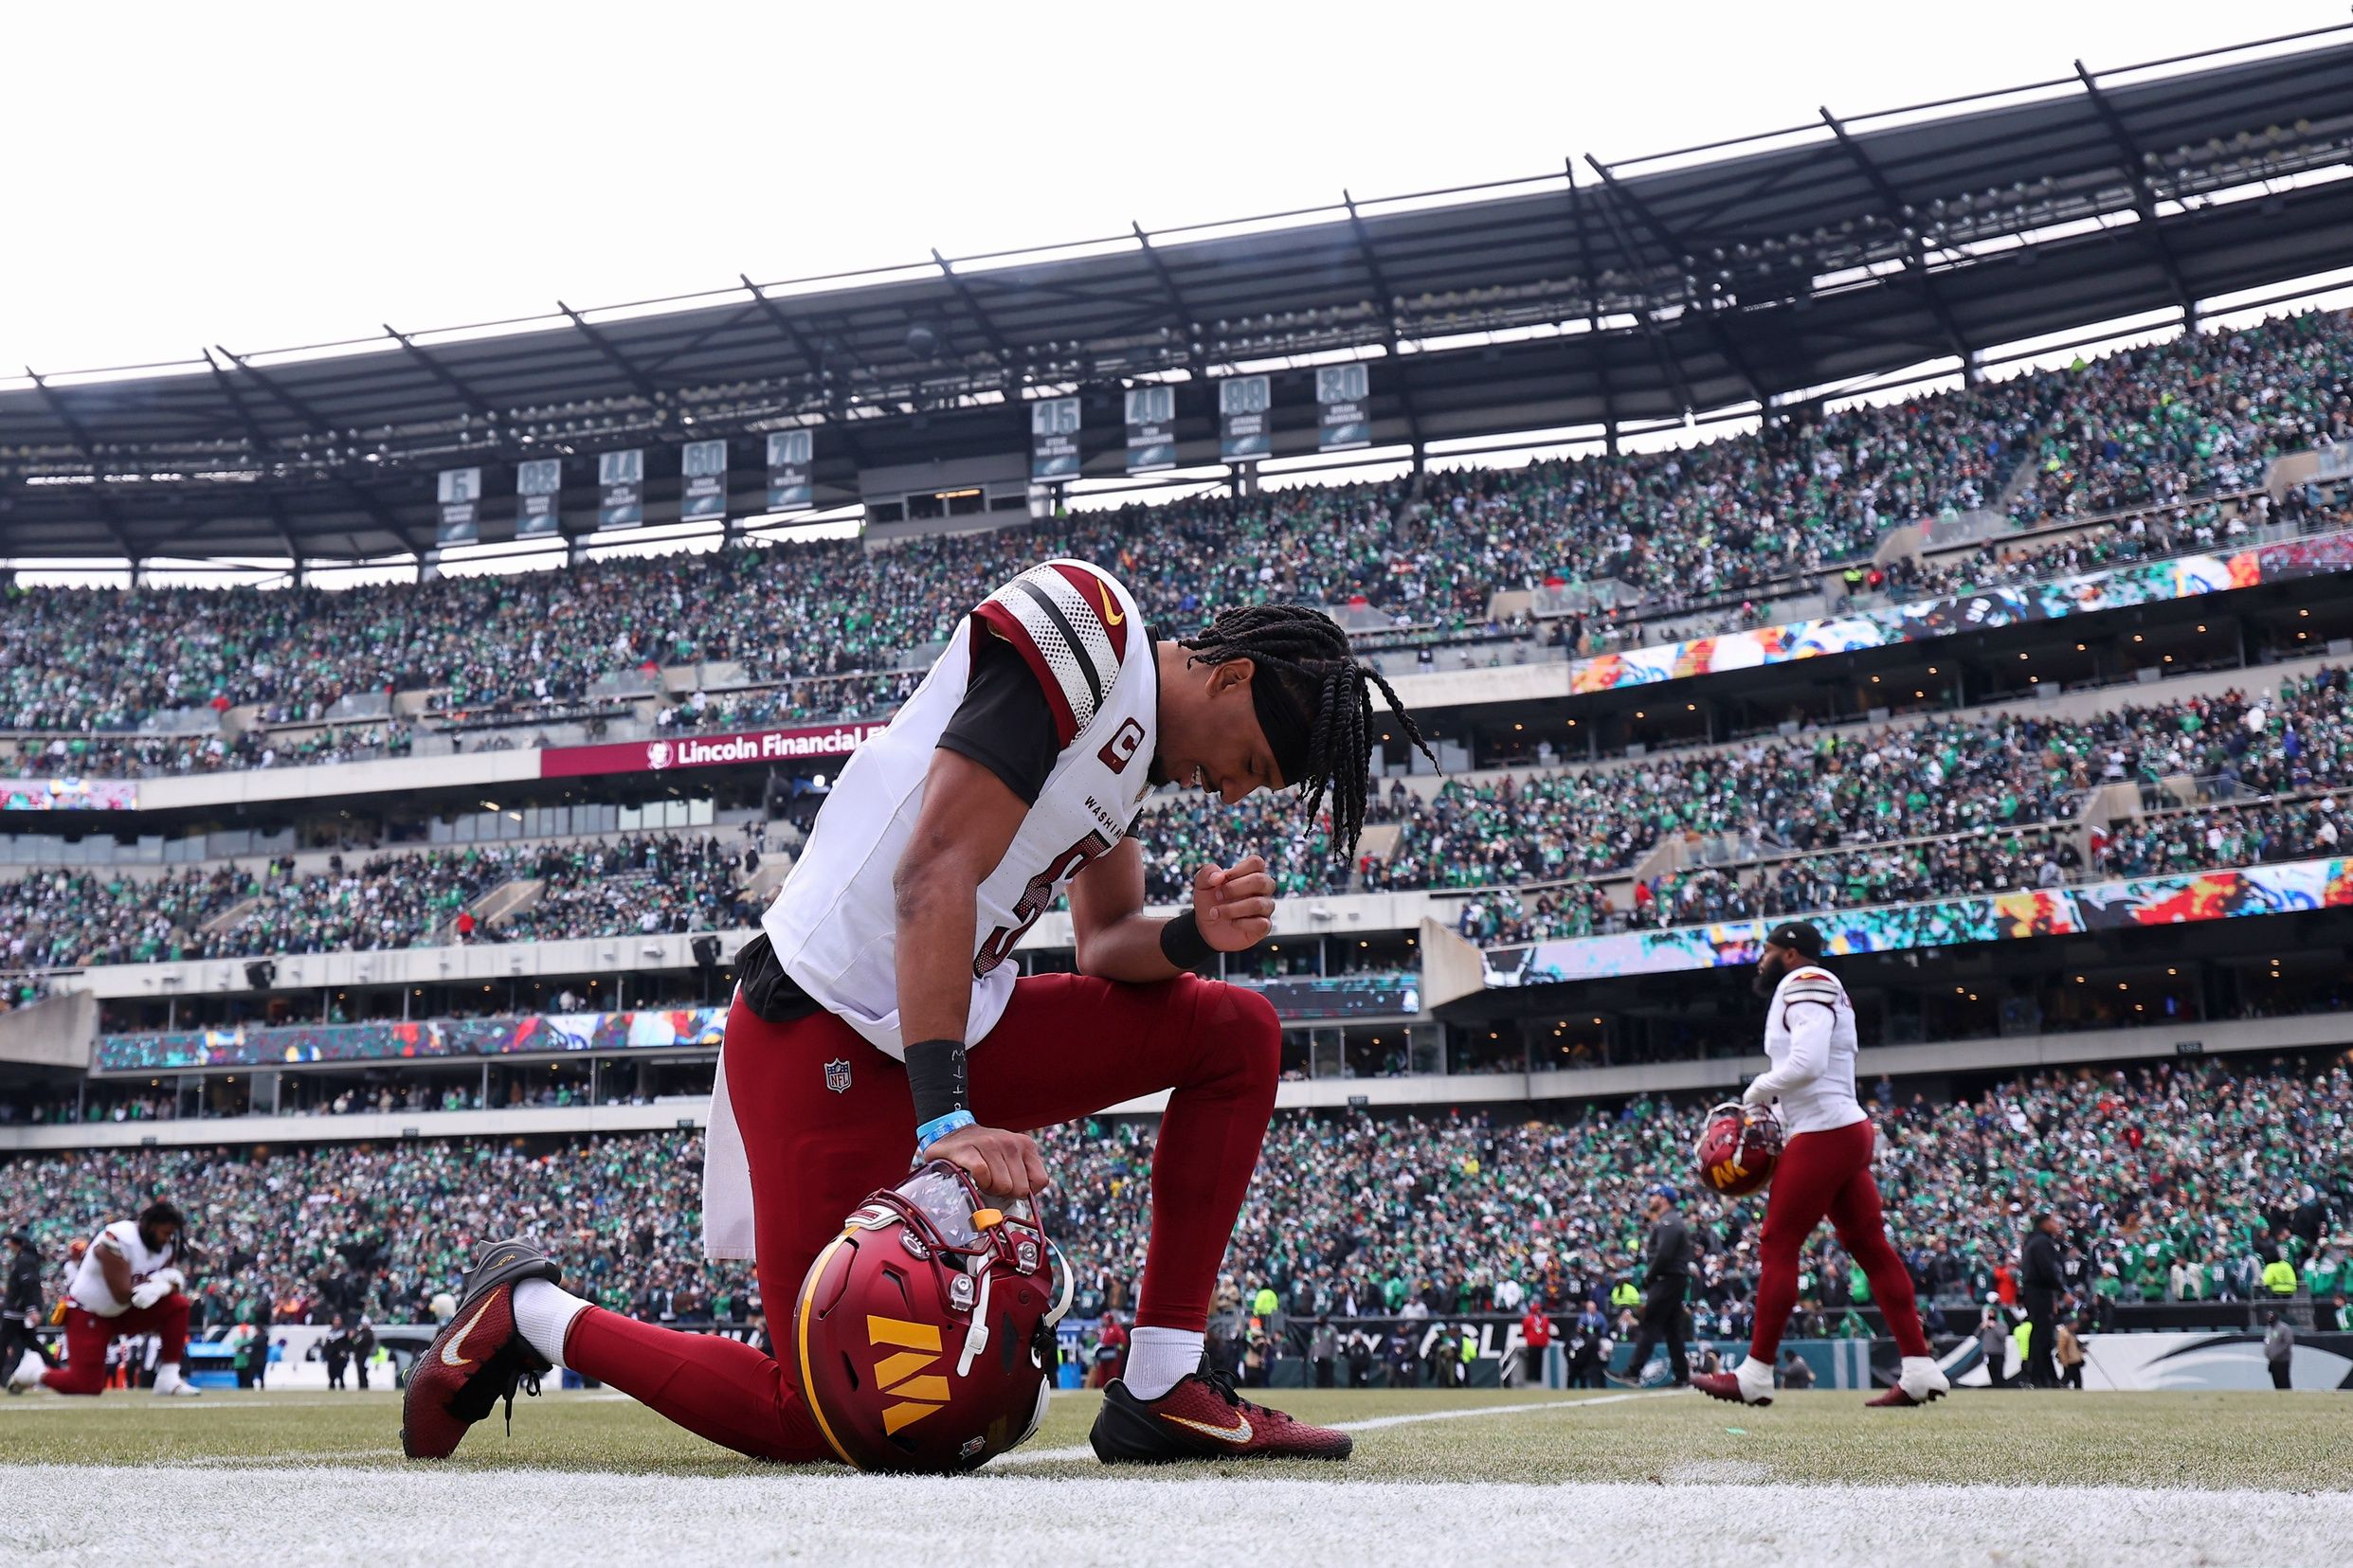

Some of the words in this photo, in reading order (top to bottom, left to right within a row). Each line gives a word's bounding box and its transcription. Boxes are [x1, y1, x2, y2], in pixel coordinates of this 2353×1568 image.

[1225, 379, 1265, 415] 99
[1322, 366, 1364, 404] 20
[1039, 400, 1077, 436] 15
[1131, 388, 1169, 424] 40
[773, 433, 808, 466] 70
[605, 451, 638, 485] 44
[452, 472, 469, 504] 5
[678, 736, 758, 764] Lincoln
[762, 727, 861, 757] Financial
[1112, 724, 1141, 762] C
[973, 828, 1112, 980] 5
[831, 1073, 848, 1087] NFL
[903, 1228, 931, 1256] OAKLEY
